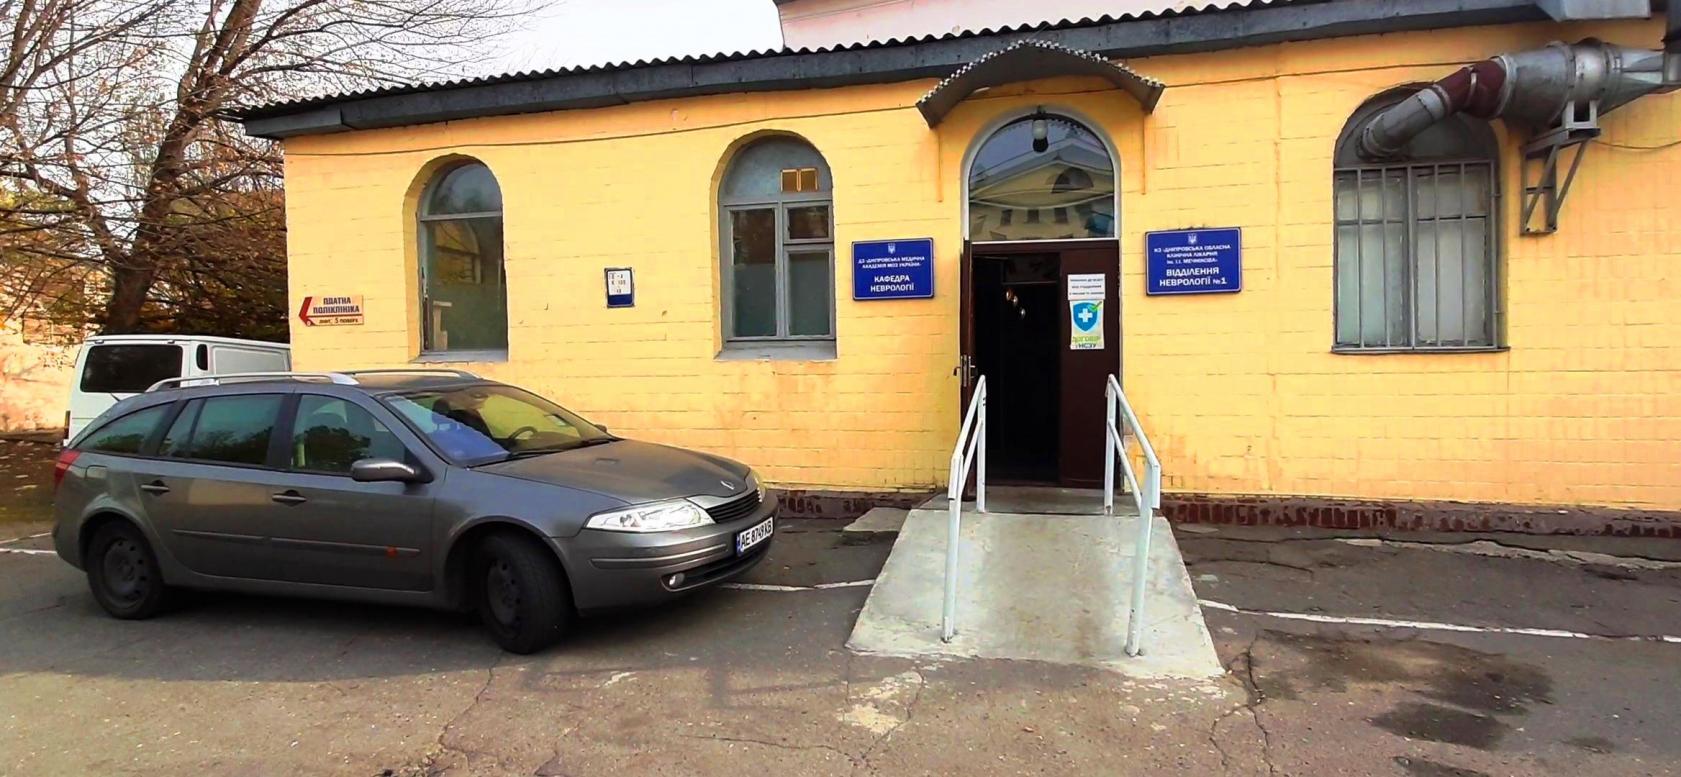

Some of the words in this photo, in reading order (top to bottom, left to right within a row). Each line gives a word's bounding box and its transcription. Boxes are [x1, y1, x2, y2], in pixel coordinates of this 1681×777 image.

[1166, 267, 1219, 276] ВІДДІЛЕННЯ
[874, 274, 910, 283] КАФЕДРА
[1160, 276, 1211, 287] НЕВРОЛОГІЇ
[870, 283, 915, 292] НЕВРОЛОГІЇ
[323, 296, 351, 305] ПЛАТНА
[313, 305, 360, 314] ПОЛІКЛІНІКА
[741, 532, 750, 547] AE
